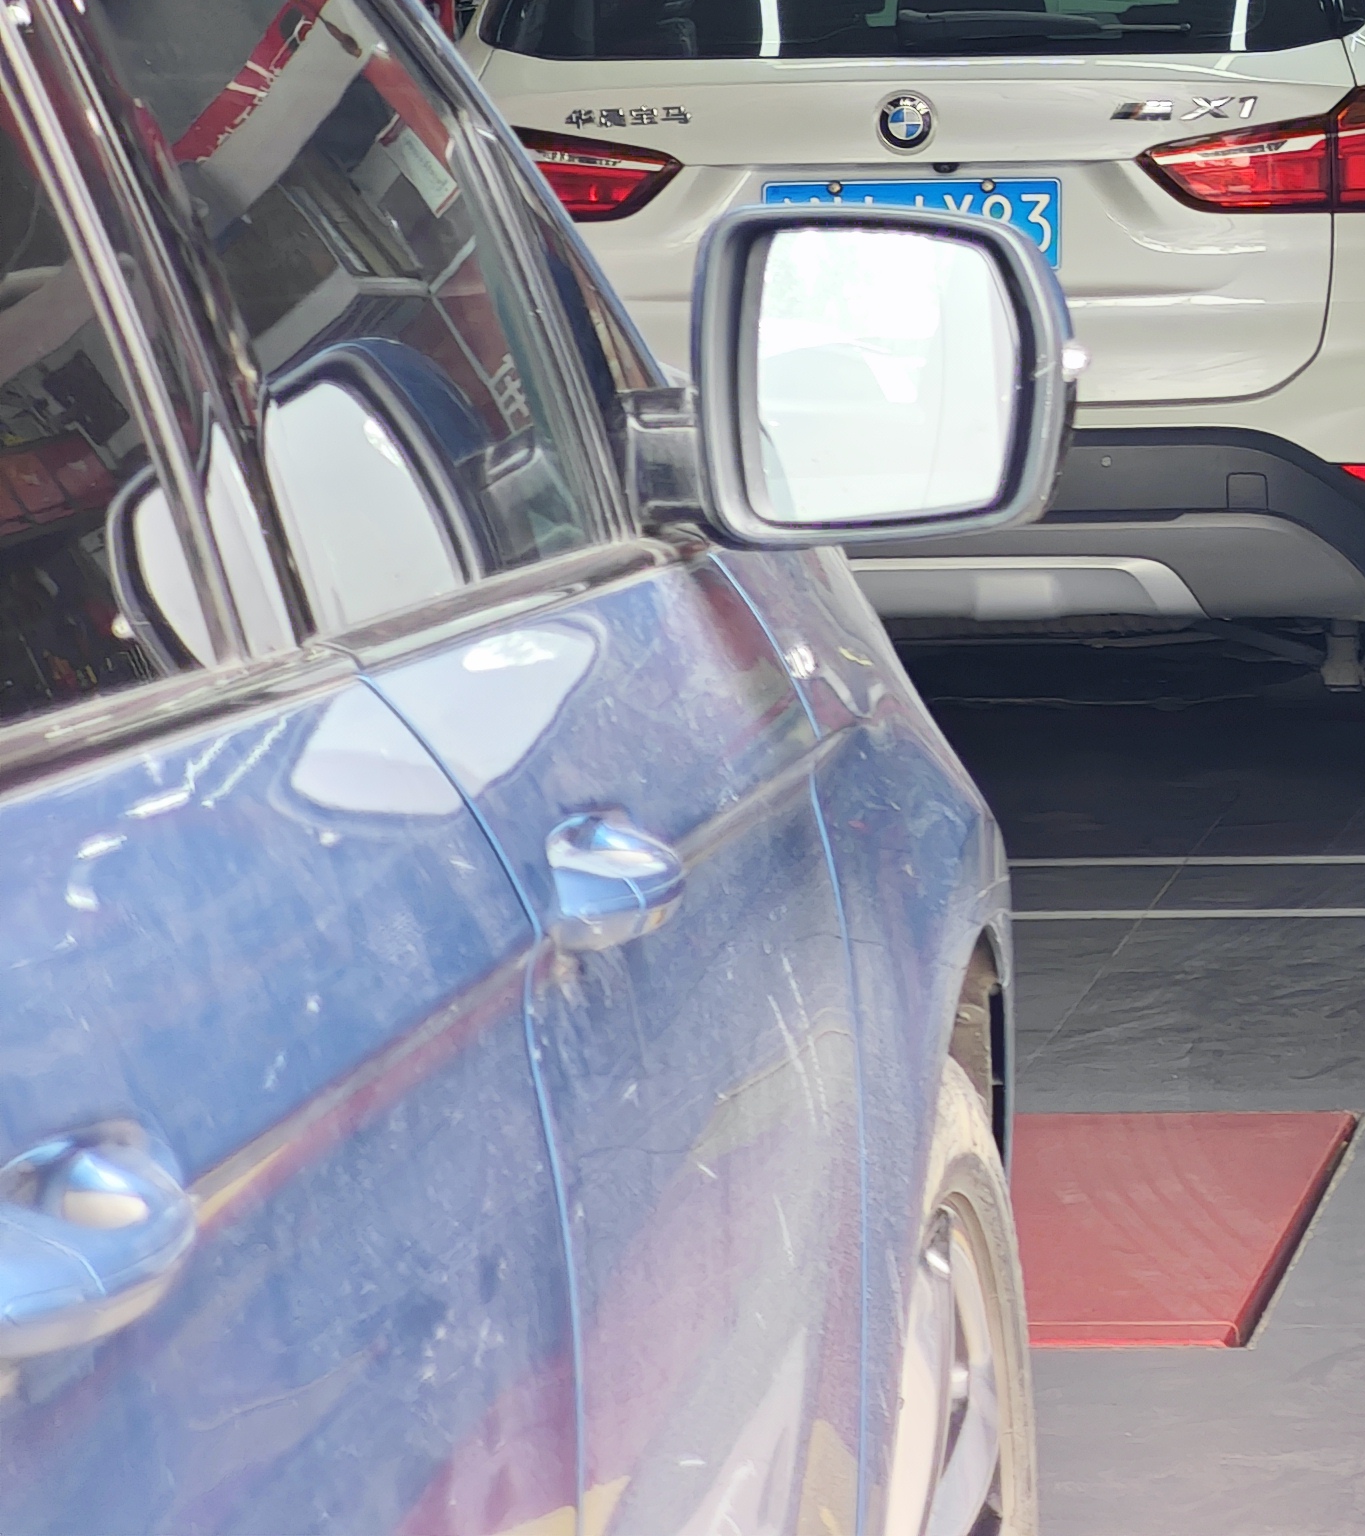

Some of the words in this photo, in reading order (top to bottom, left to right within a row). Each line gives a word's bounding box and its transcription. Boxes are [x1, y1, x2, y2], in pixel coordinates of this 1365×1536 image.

[564, 104, 692, 130] 华晨宝马
[1179, 95, 1259, 121] X1
